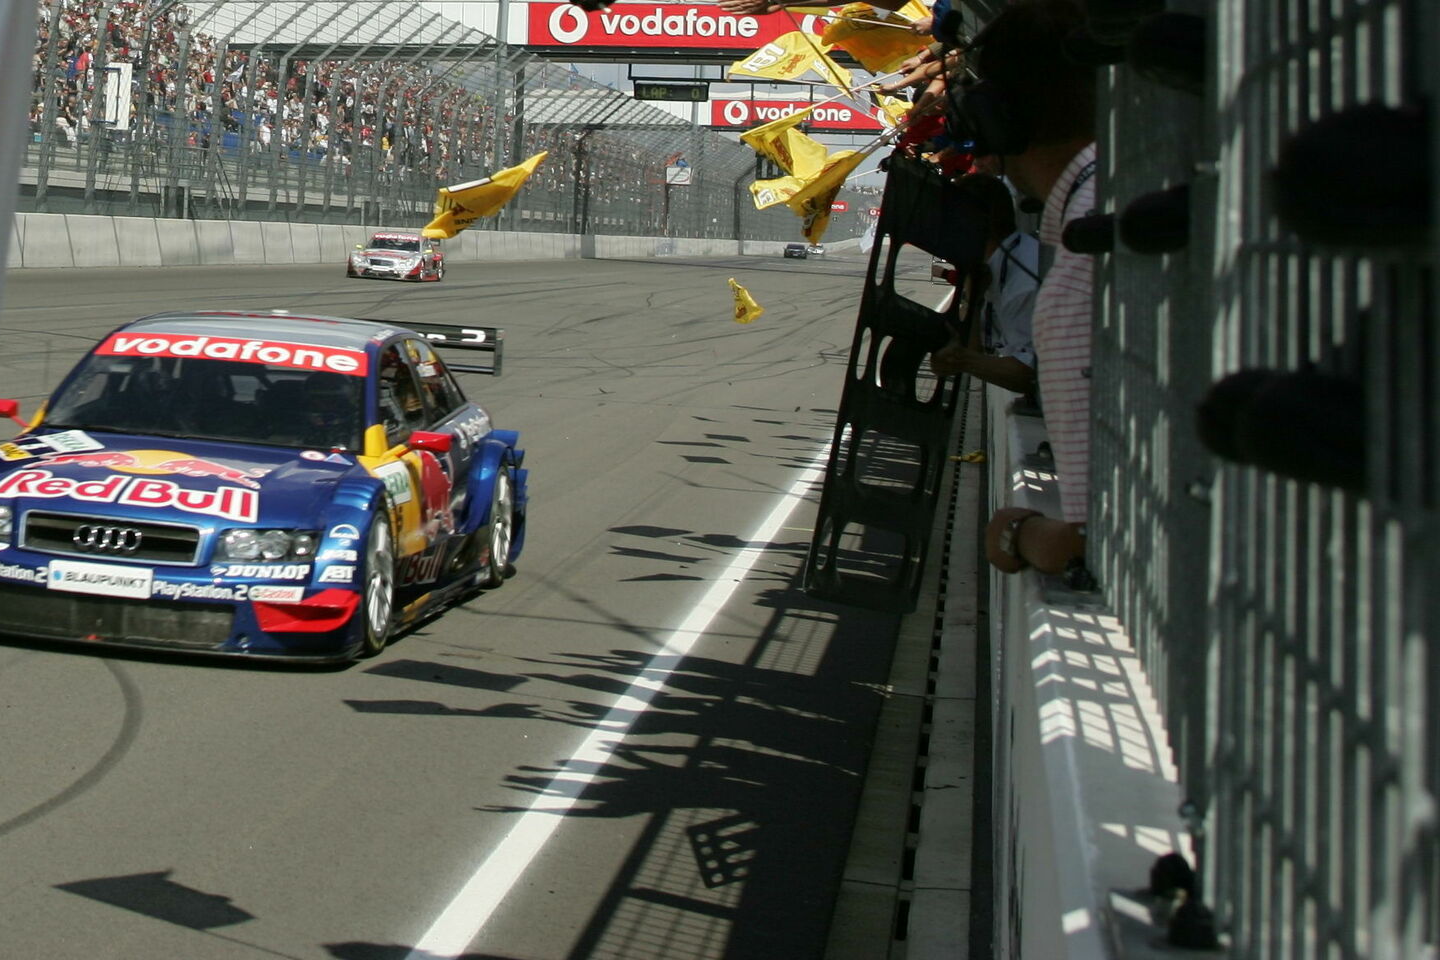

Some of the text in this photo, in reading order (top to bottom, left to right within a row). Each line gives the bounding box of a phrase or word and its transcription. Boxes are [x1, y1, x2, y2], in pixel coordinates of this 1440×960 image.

[601, 9, 758, 38] vodafone
[112, 337, 359, 372] vodafone
[118, 479, 259, 523] Bull
[65, 570, 147, 589] BLAUPUNKT
[225, 565, 310, 580] DUNLOP
[319, 565, 356, 583] ABT
